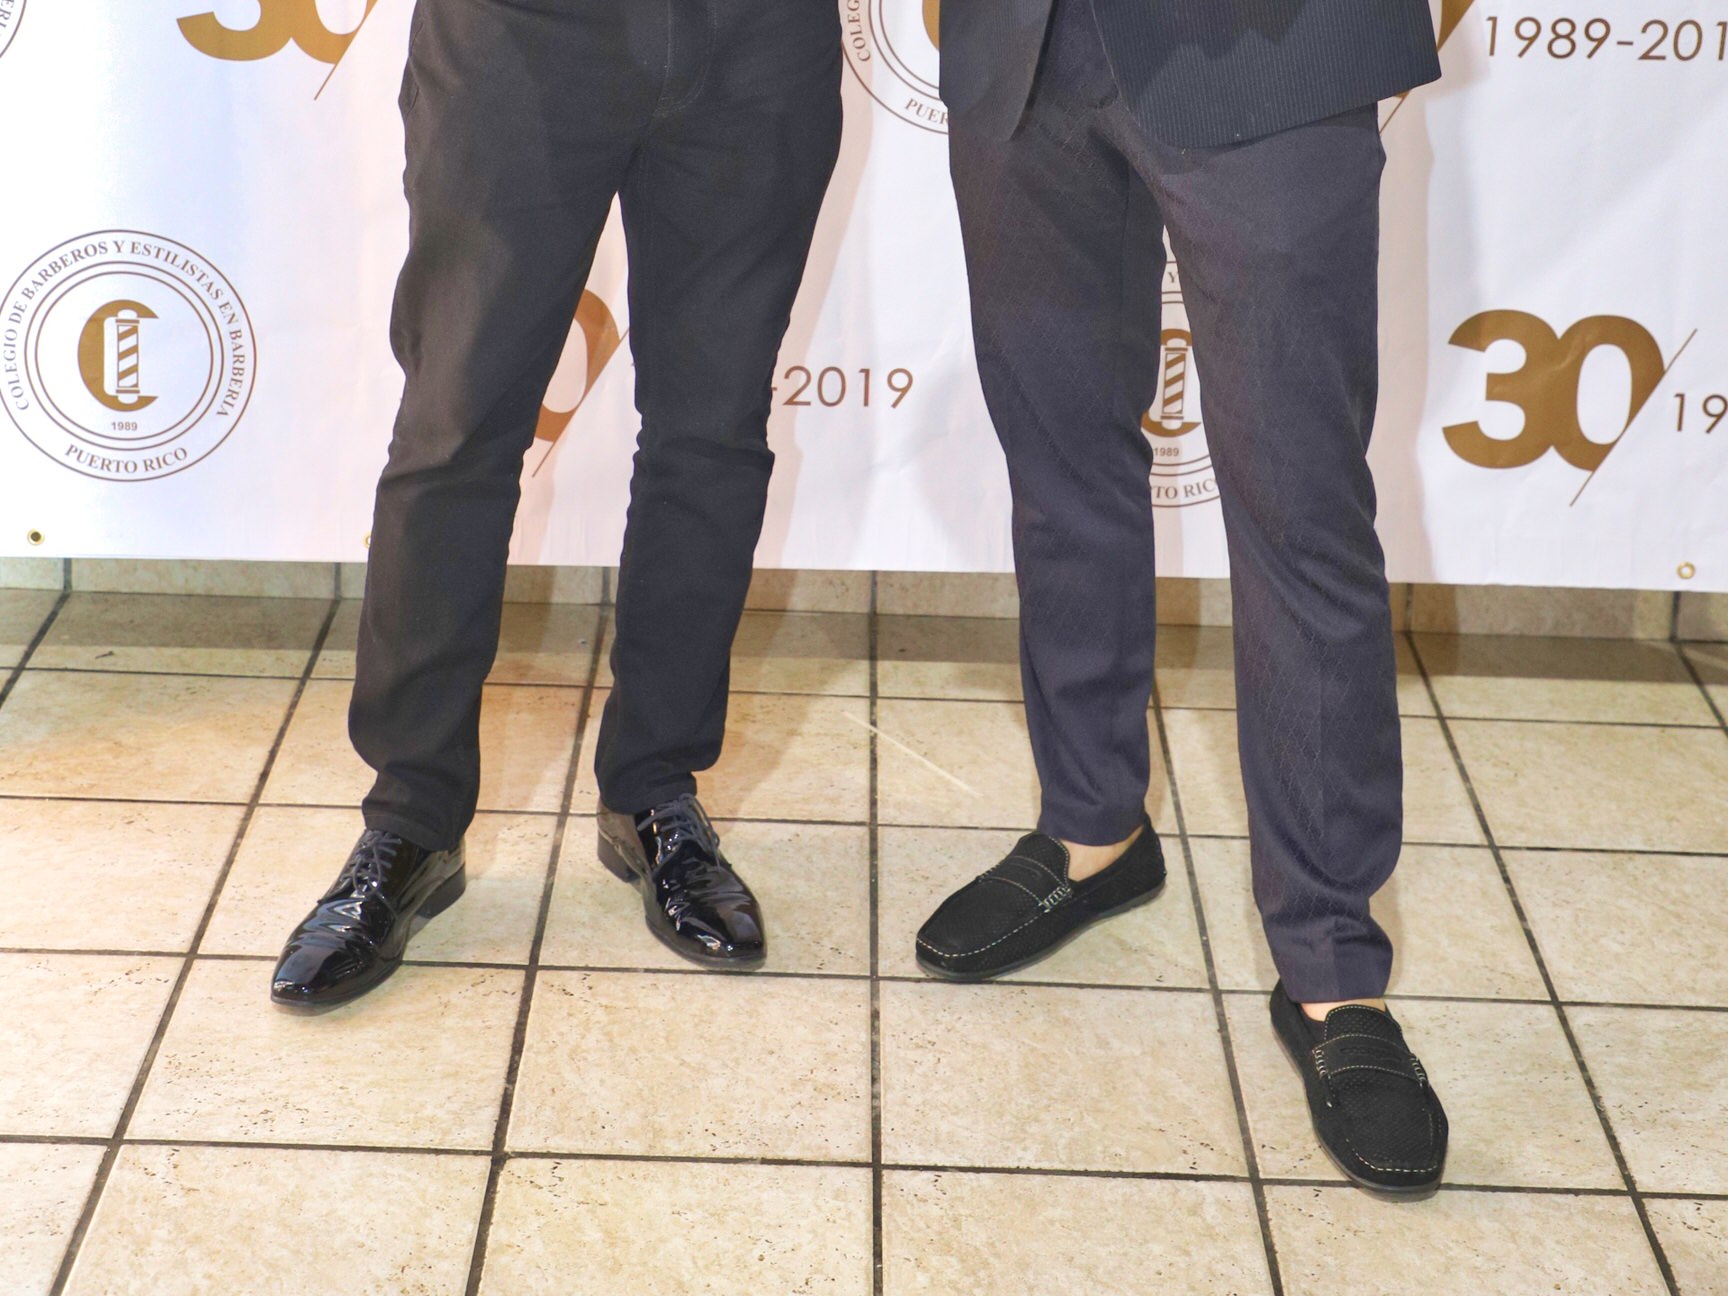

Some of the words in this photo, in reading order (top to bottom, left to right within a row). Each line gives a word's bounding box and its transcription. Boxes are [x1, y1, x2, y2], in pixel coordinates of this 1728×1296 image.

[112, 240, 125, 253] Y
[20, 240, 108, 300] BARBEROS
[130, 241, 223, 301] ESTILISTAS
[14, 301, 28, 325] DE
[218, 301, 239, 325] EN
[3, 327, 30, 411] COLEGIO
[216, 328, 245, 418] BARBERIA
[111, 421, 138, 431] 1989
[64, 443, 138, 474] PUERTO
[144, 446, 188, 472] RICO
[1154, 447, 1180, 457] 1989
